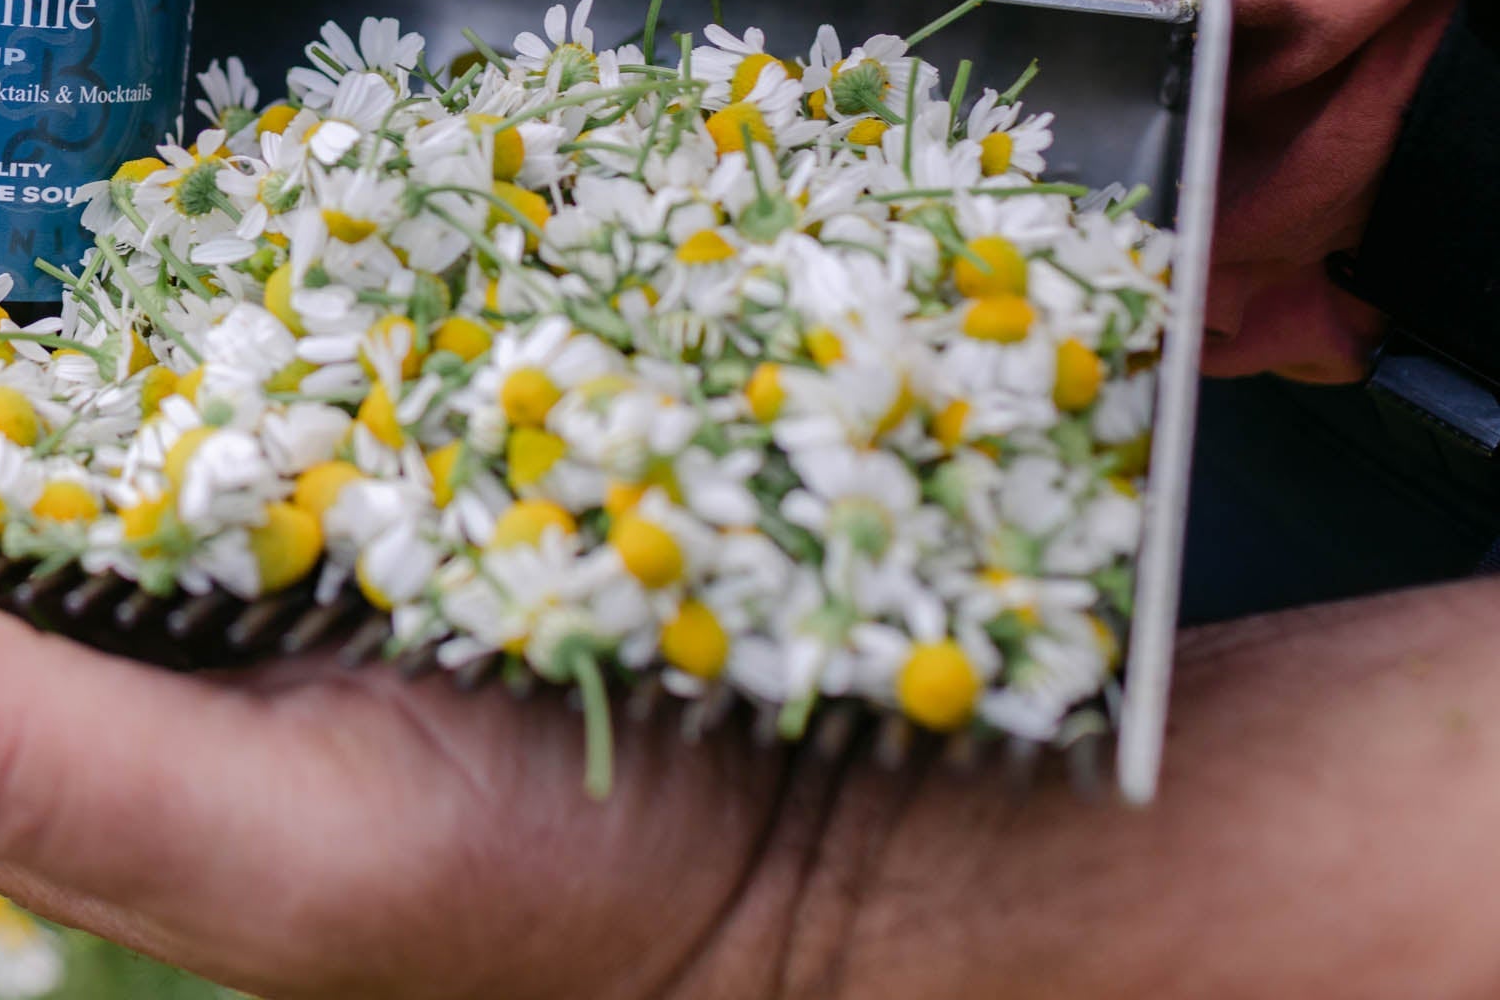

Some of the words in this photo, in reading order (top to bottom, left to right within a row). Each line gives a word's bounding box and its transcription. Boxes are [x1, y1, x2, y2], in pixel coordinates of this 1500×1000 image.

[55, 85, 73, 104] &
[79, 82, 152, 104] Mocktails
[22, 186, 81, 204] SOU
